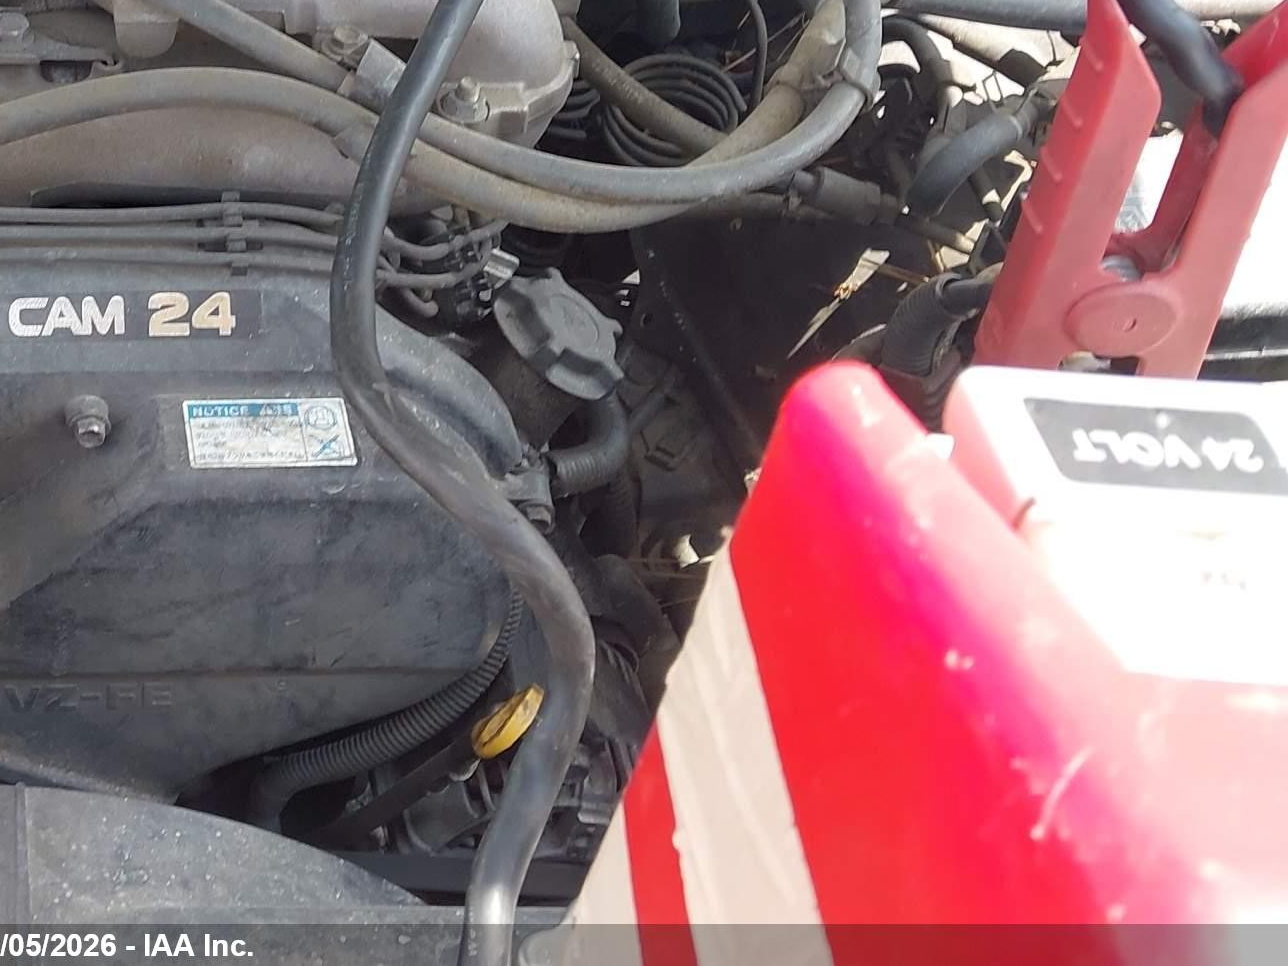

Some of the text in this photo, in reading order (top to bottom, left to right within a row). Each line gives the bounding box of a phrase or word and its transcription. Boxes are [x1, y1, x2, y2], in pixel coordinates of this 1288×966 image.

[8, 295, 126, 338] CAM
[147, 291, 237, 337] 24
[192, 405, 249, 417] NOTICE
[1071, 427, 1264, 473] 24 VOLT
